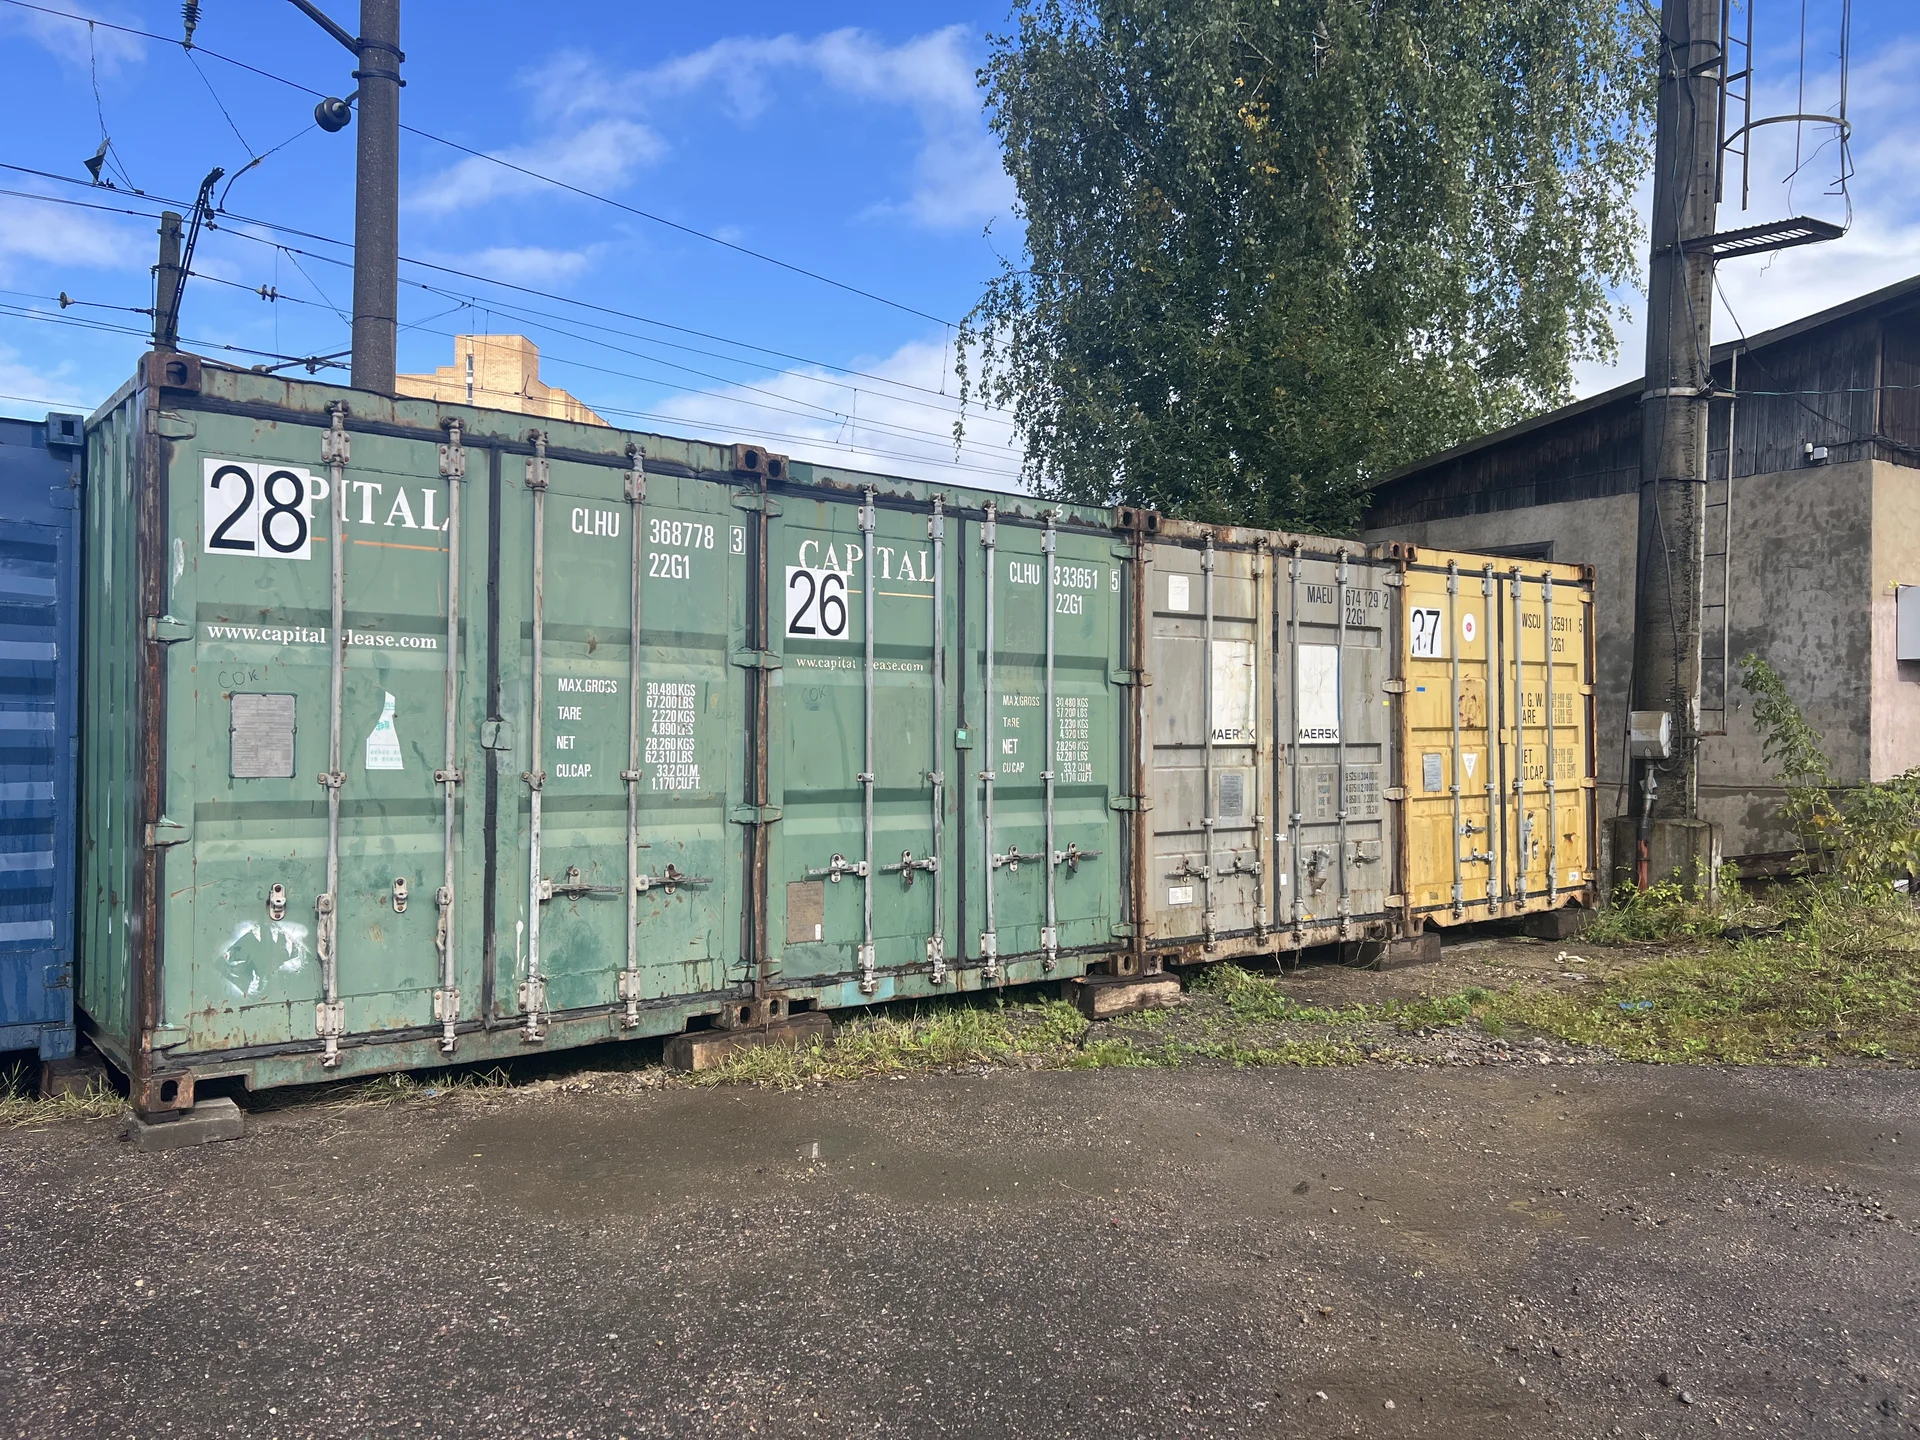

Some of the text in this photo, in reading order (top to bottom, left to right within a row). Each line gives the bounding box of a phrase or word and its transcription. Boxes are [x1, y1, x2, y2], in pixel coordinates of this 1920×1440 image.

[209, 465, 307, 553] 28
[310, 476, 449, 531] PITAL
[571, 507, 743, 552] CLHU 368778 3
[649, 552, 690, 579] 22G1
[1009, 561, 1119, 591] CLHU 333651 5
[788, 570, 847, 637] 26
[1056, 593, 1083, 615] 22G1
[1307, 586, 1333, 604] MAEU
[1383, 593, 1389, 610] 2
[1345, 608, 1366, 625] 22G1
[1521, 612, 1541, 629] WSCU
[1578, 618, 1583, 633] 5
[558, 678, 696, 696] MAX.GROSS 30.480 KGS
[646, 696, 694, 709] 67.200 LBS
[1077, 697, 1089, 708] KGS
[558, 706, 695, 723] TARE 2.220 KGS
[1077, 708, 1088, 718] LBS
[1522, 709, 1537, 724] ARE
[651, 723, 677, 736] 4.890
[1003, 717, 1020, 728] TARE
[1077, 719, 1089, 729] KGS
[1077, 729, 1088, 739] LBS
[556, 736, 695, 751] NET 28.260 KGS
[1002, 738, 1019, 755] NET
[1077, 740, 1089, 751] KGS
[645, 751, 693, 763] 62.310 LBS
[1077, 751, 1088, 761] LBS
[556, 763, 700, 778] CU.CAP. 33.2 CU.M.
[1523, 766, 1545, 780] U.CAP.
[651, 777, 676, 790] 1.170
